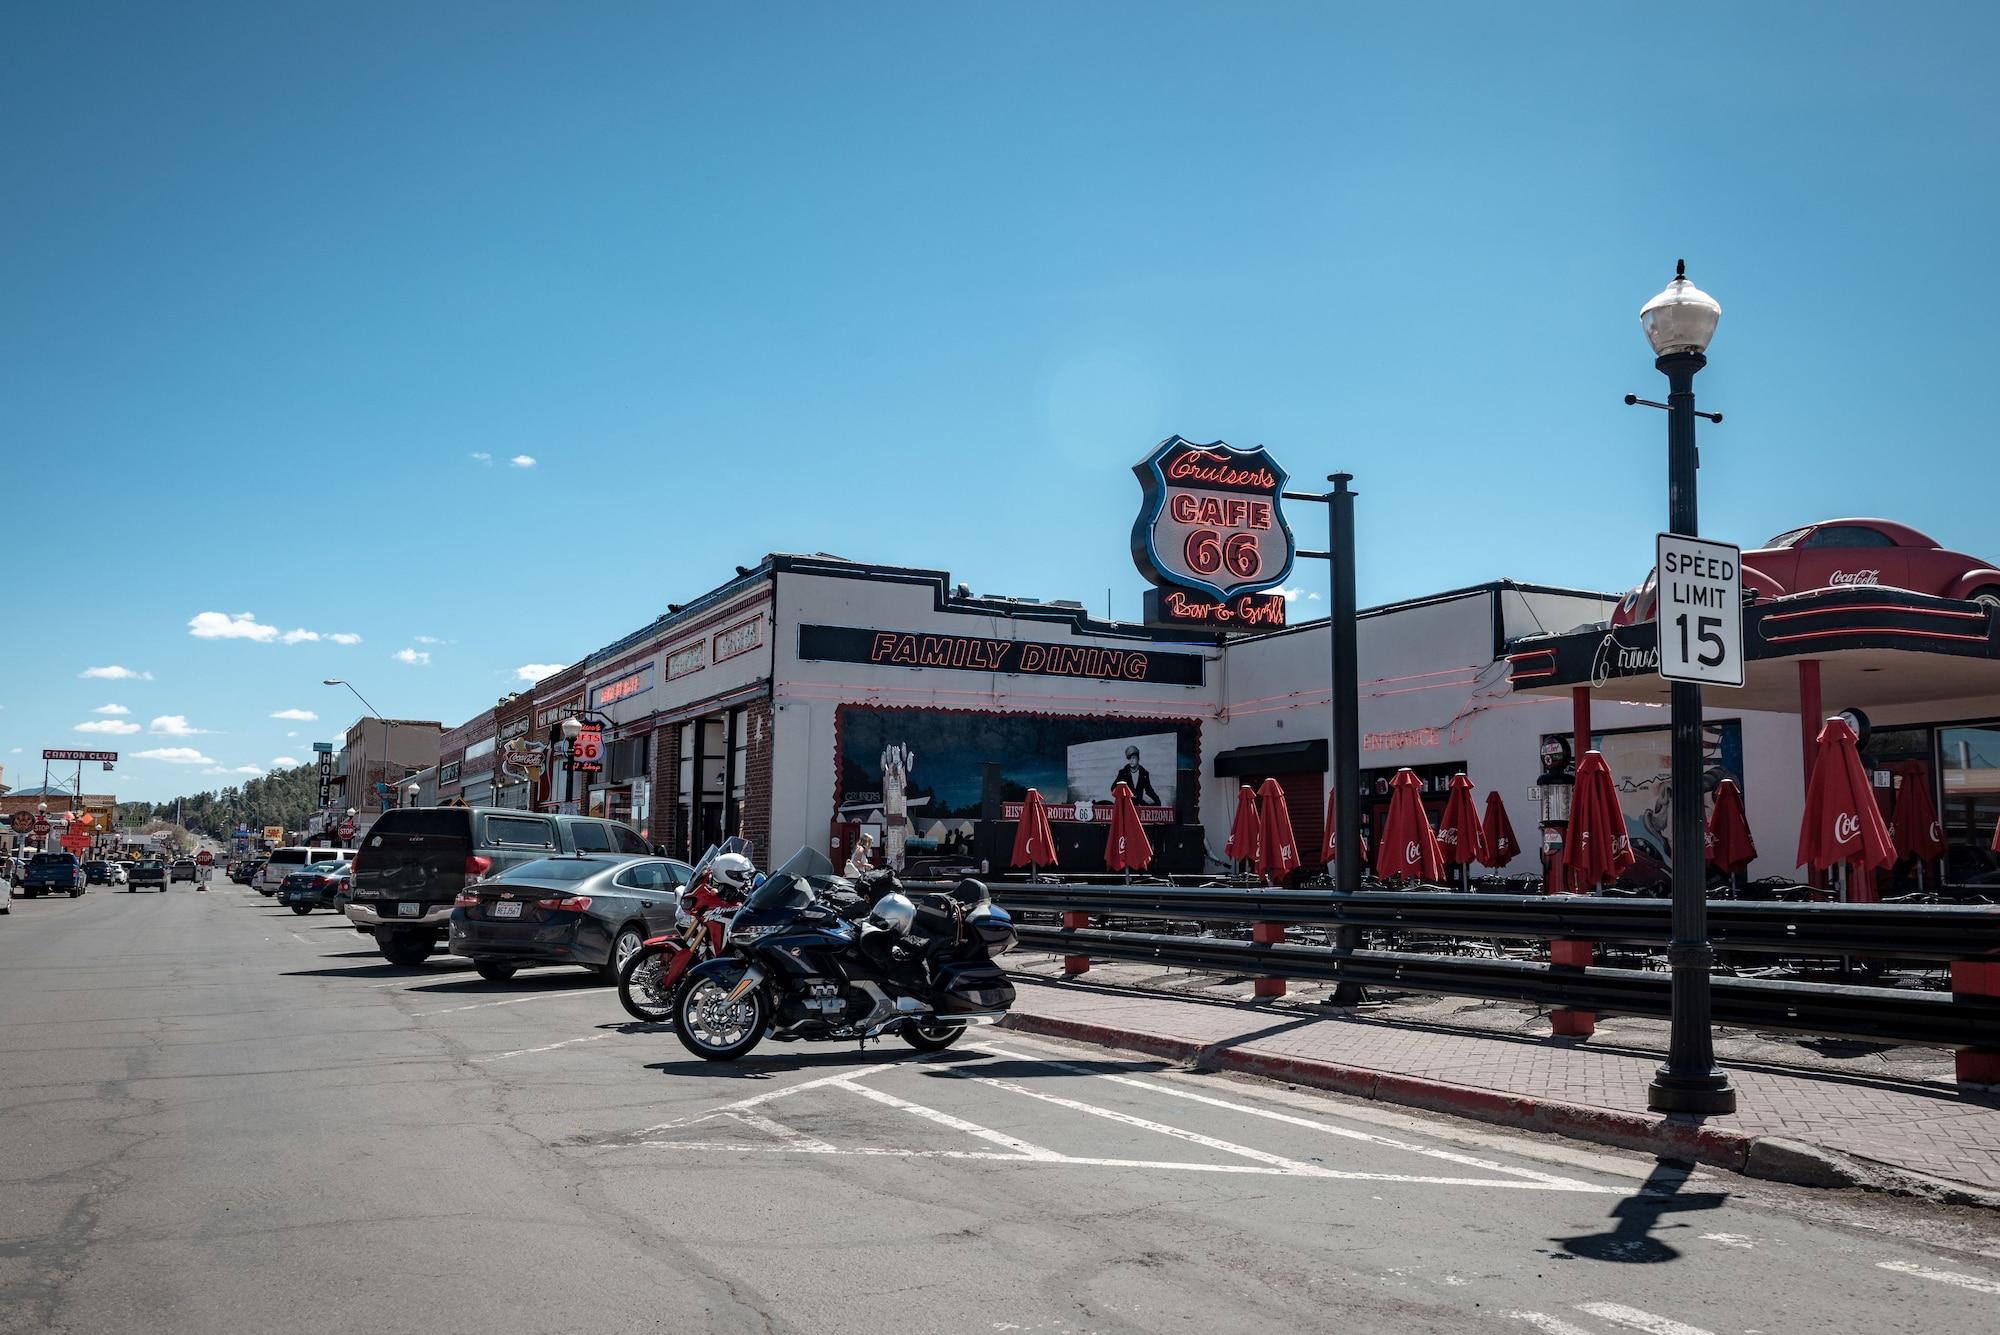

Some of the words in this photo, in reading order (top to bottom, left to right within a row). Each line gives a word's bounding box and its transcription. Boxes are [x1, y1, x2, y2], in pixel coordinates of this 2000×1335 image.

[1171, 493, 1271, 530] CAFE
[1184, 528, 1262, 578] 66
[1665, 552, 1734, 581] SPEED
[1829, 569, 1880, 586] Coca-Cola
[1166, 592, 1211, 618] Bar
[1239, 596, 1284, 624] Grill
[1673, 582, 1726, 609] LIMIT
[1676, 614, 1726, 667] 15
[871, 633, 1010, 668] FAMILY
[1020, 645, 1147, 679] DINING
[44, 751, 86, 760] CANYON
[89, 752, 117, 761] CLUB
[319, 753, 331, 807] HOTEL
[34, 824, 50, 832] STOP
[1047, 806, 1075, 820] ROUTE
[1080, 809, 1088, 820] 66
[1140, 810, 1174, 822] ARIZONA
